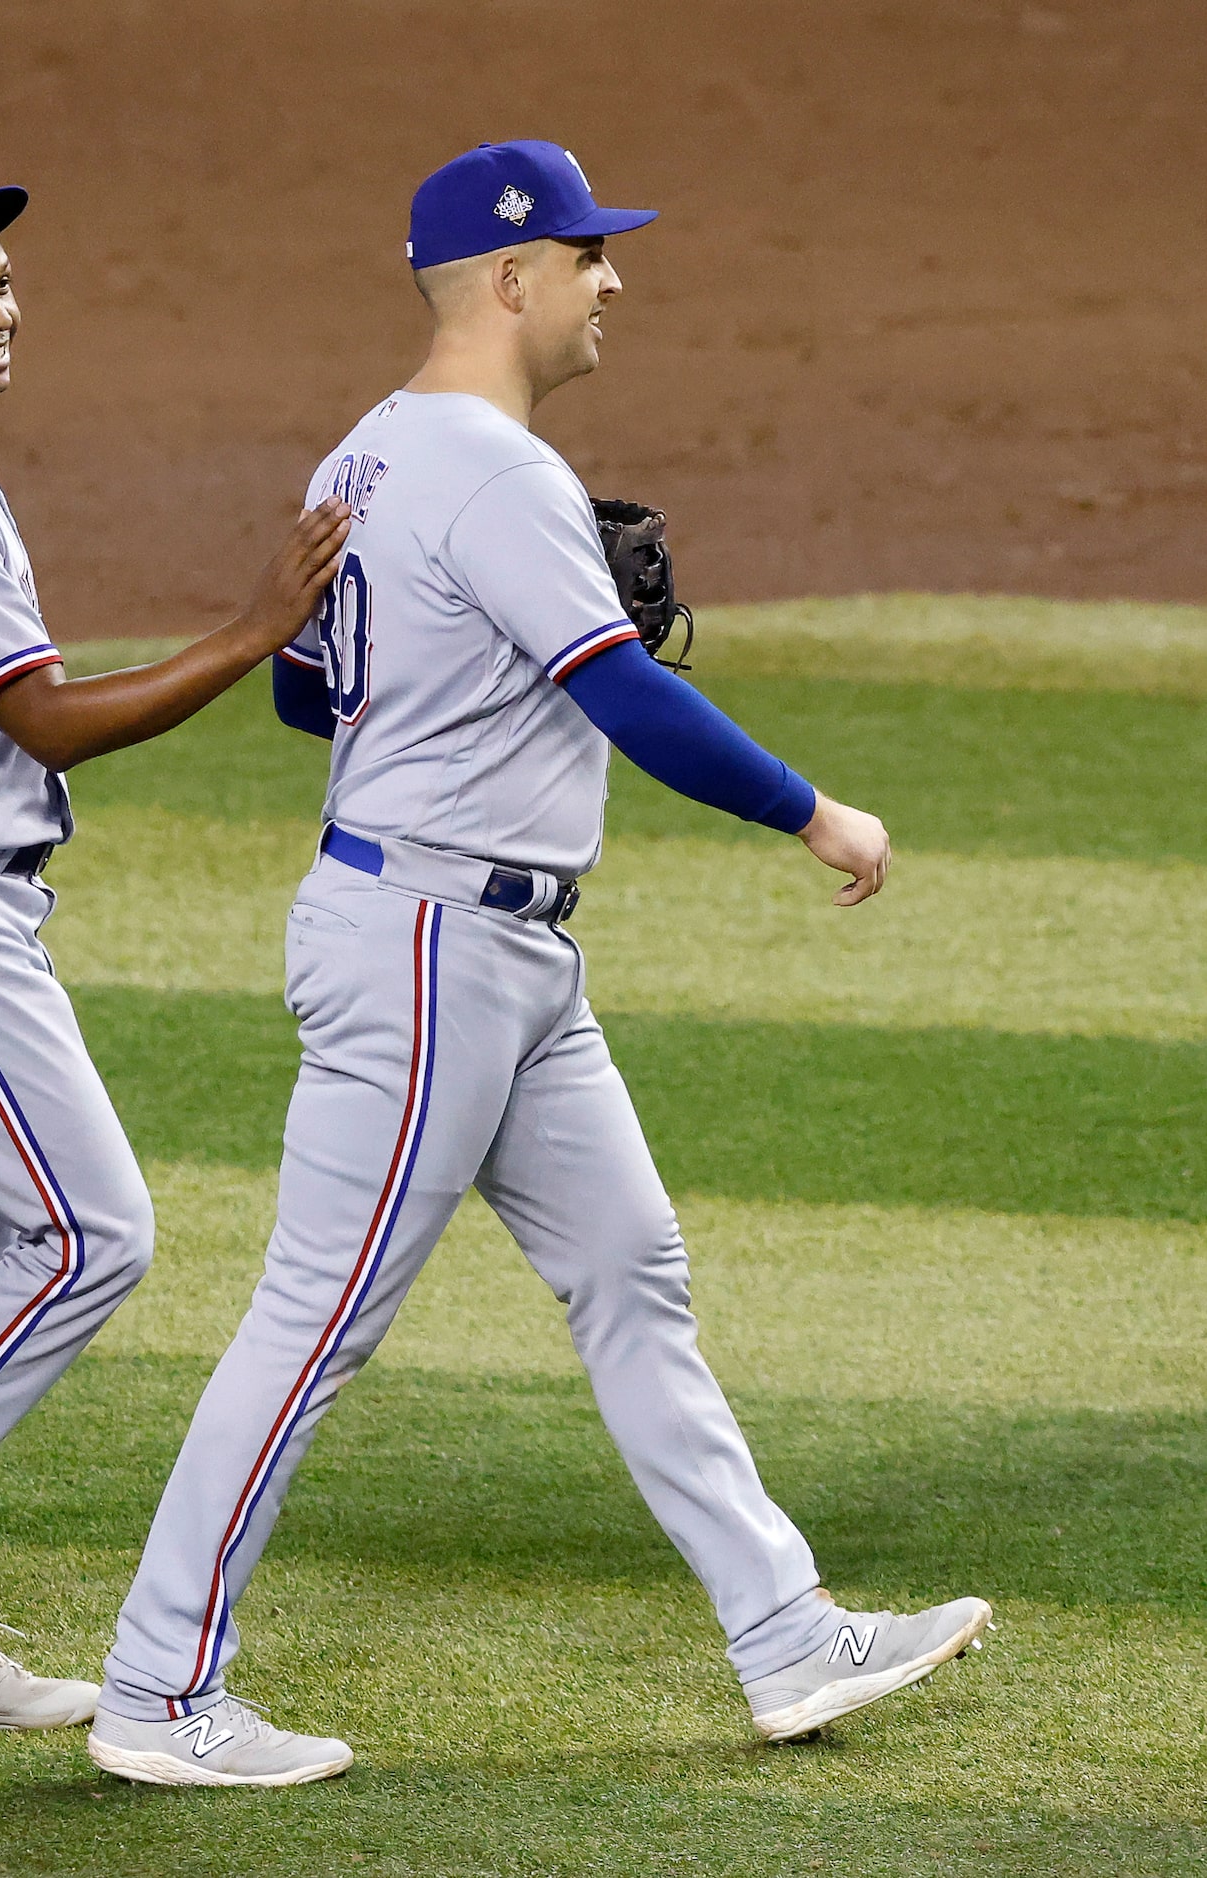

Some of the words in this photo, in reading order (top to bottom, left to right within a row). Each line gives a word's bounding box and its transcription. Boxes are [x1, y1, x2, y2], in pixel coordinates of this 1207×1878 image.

[496, 195, 532, 212] WORLD
[499, 203, 533, 219] SERIES
[318, 548, 374, 727] 30
[825, 1623, 878, 1667] N
[170, 1712, 235, 1759] N
